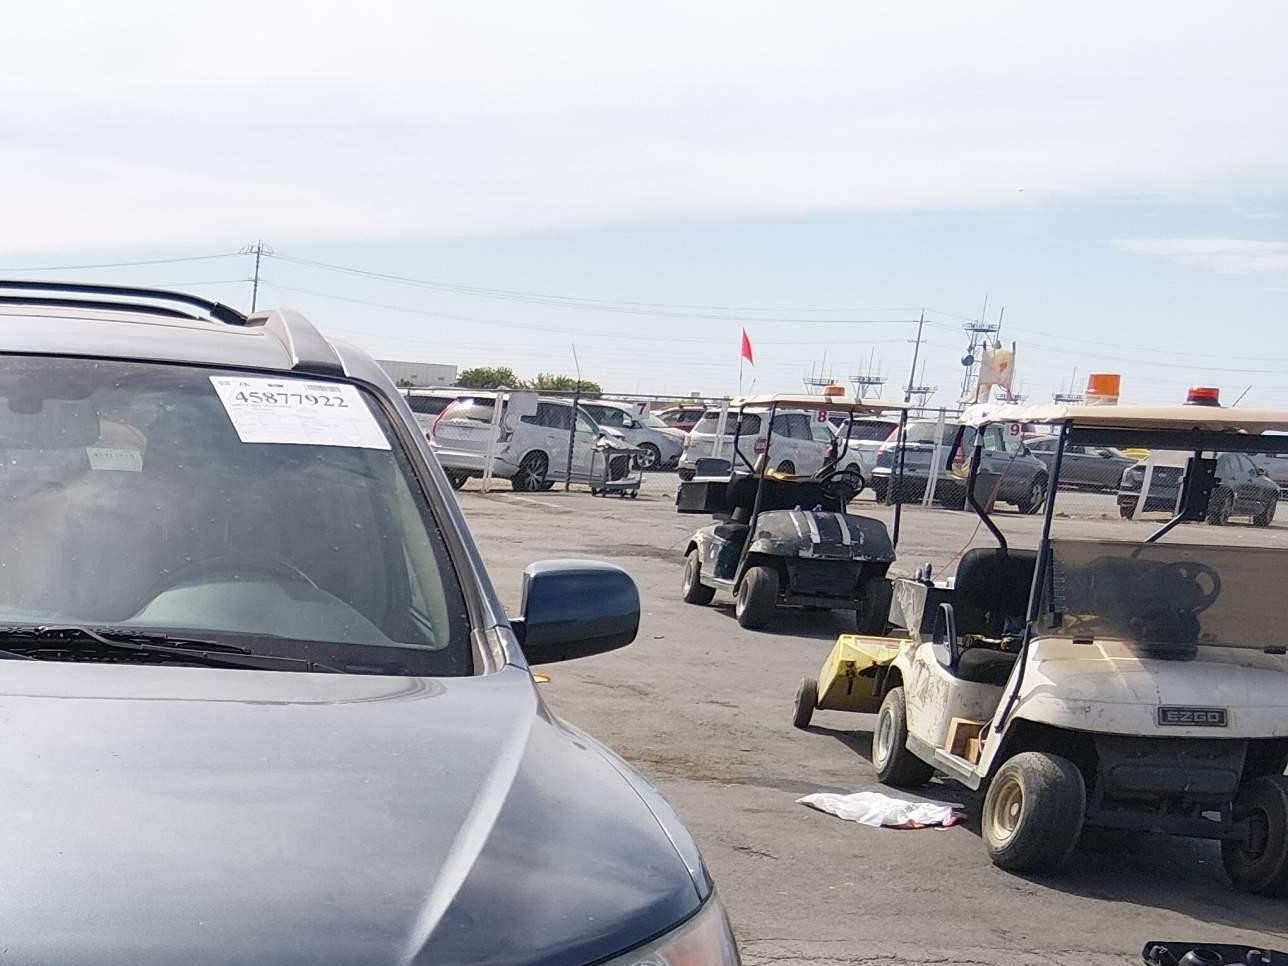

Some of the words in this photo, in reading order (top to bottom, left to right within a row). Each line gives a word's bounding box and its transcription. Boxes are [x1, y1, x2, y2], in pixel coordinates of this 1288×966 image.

[235, 391, 349, 408] 45877922
[637, 403, 647, 415] 7
[817, 411, 827, 423] 8
[1010, 423, 1020, 436] 9
[1167, 711, 1219, 722] EZGO
